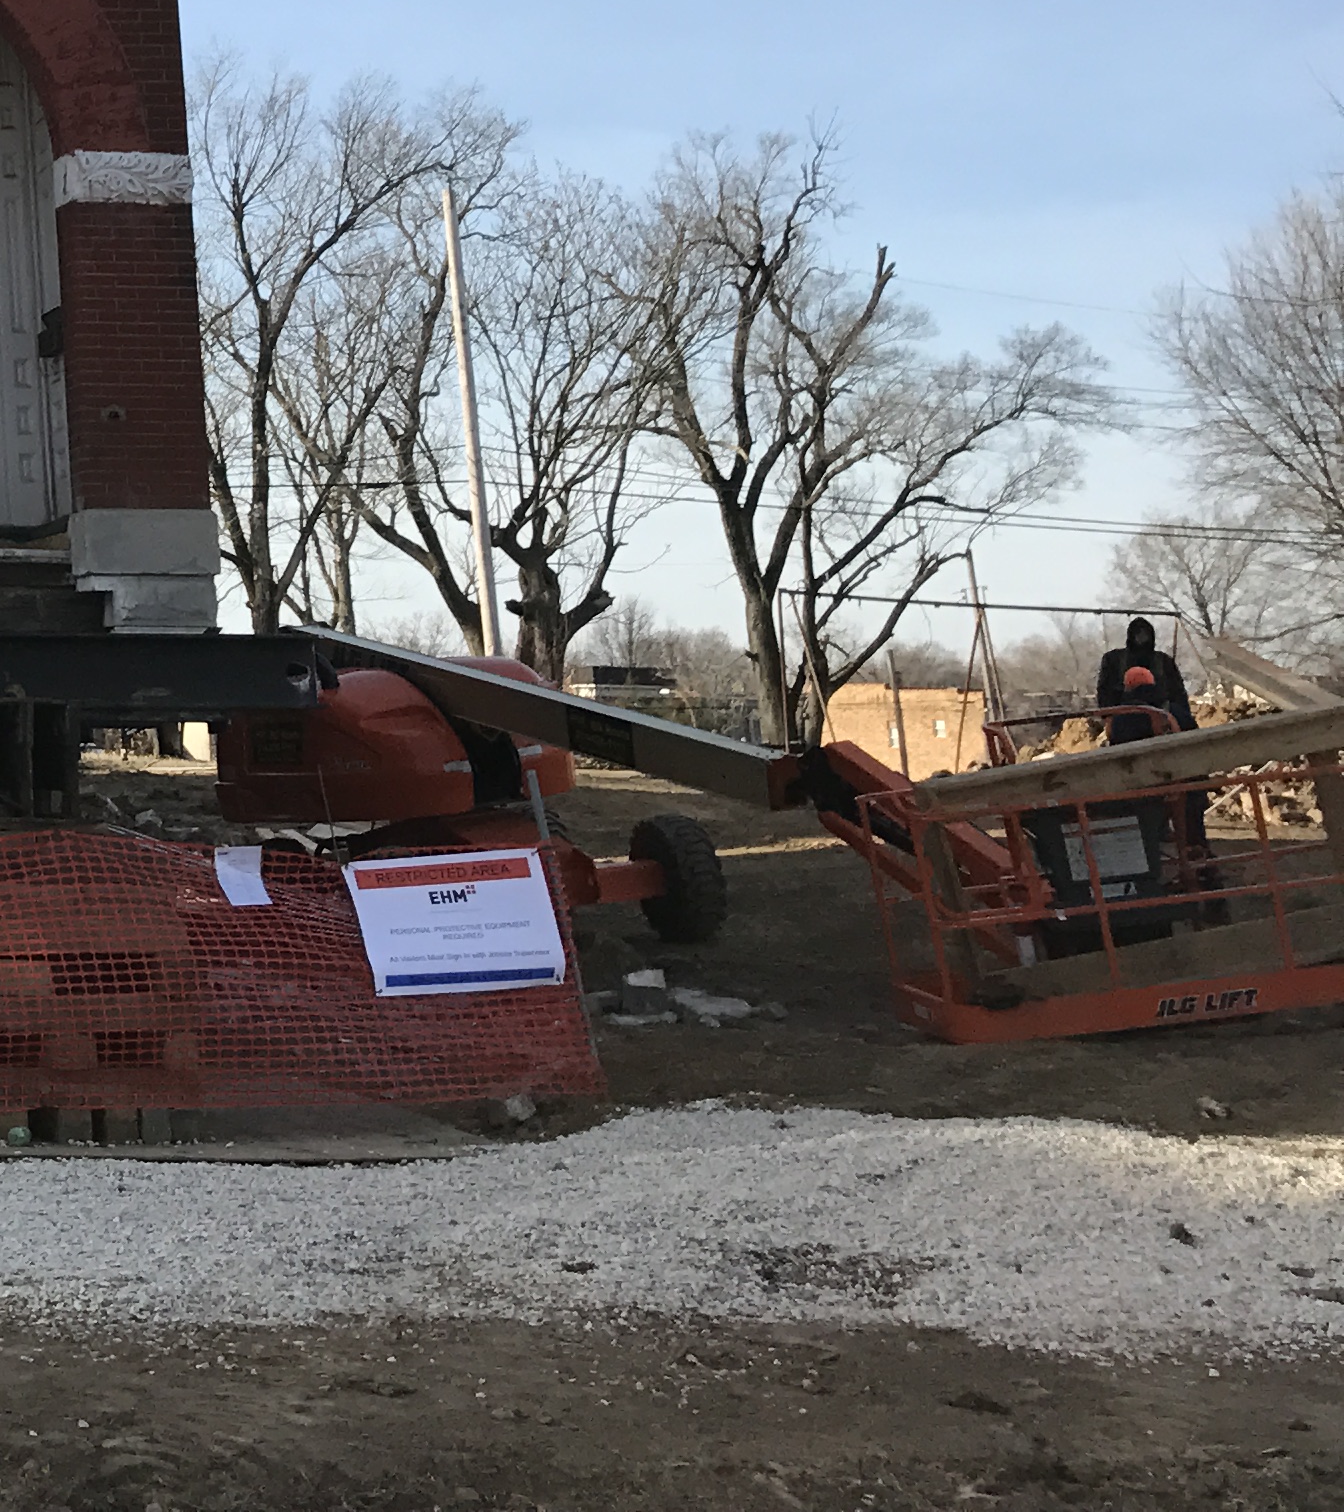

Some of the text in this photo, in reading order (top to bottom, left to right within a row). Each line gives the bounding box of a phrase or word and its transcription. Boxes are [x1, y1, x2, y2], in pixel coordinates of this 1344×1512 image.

[375, 863, 511, 885] RESTRICTED AREA
[428, 888, 469, 905] EHM
[1204, 988, 1259, 1011] LIFT
